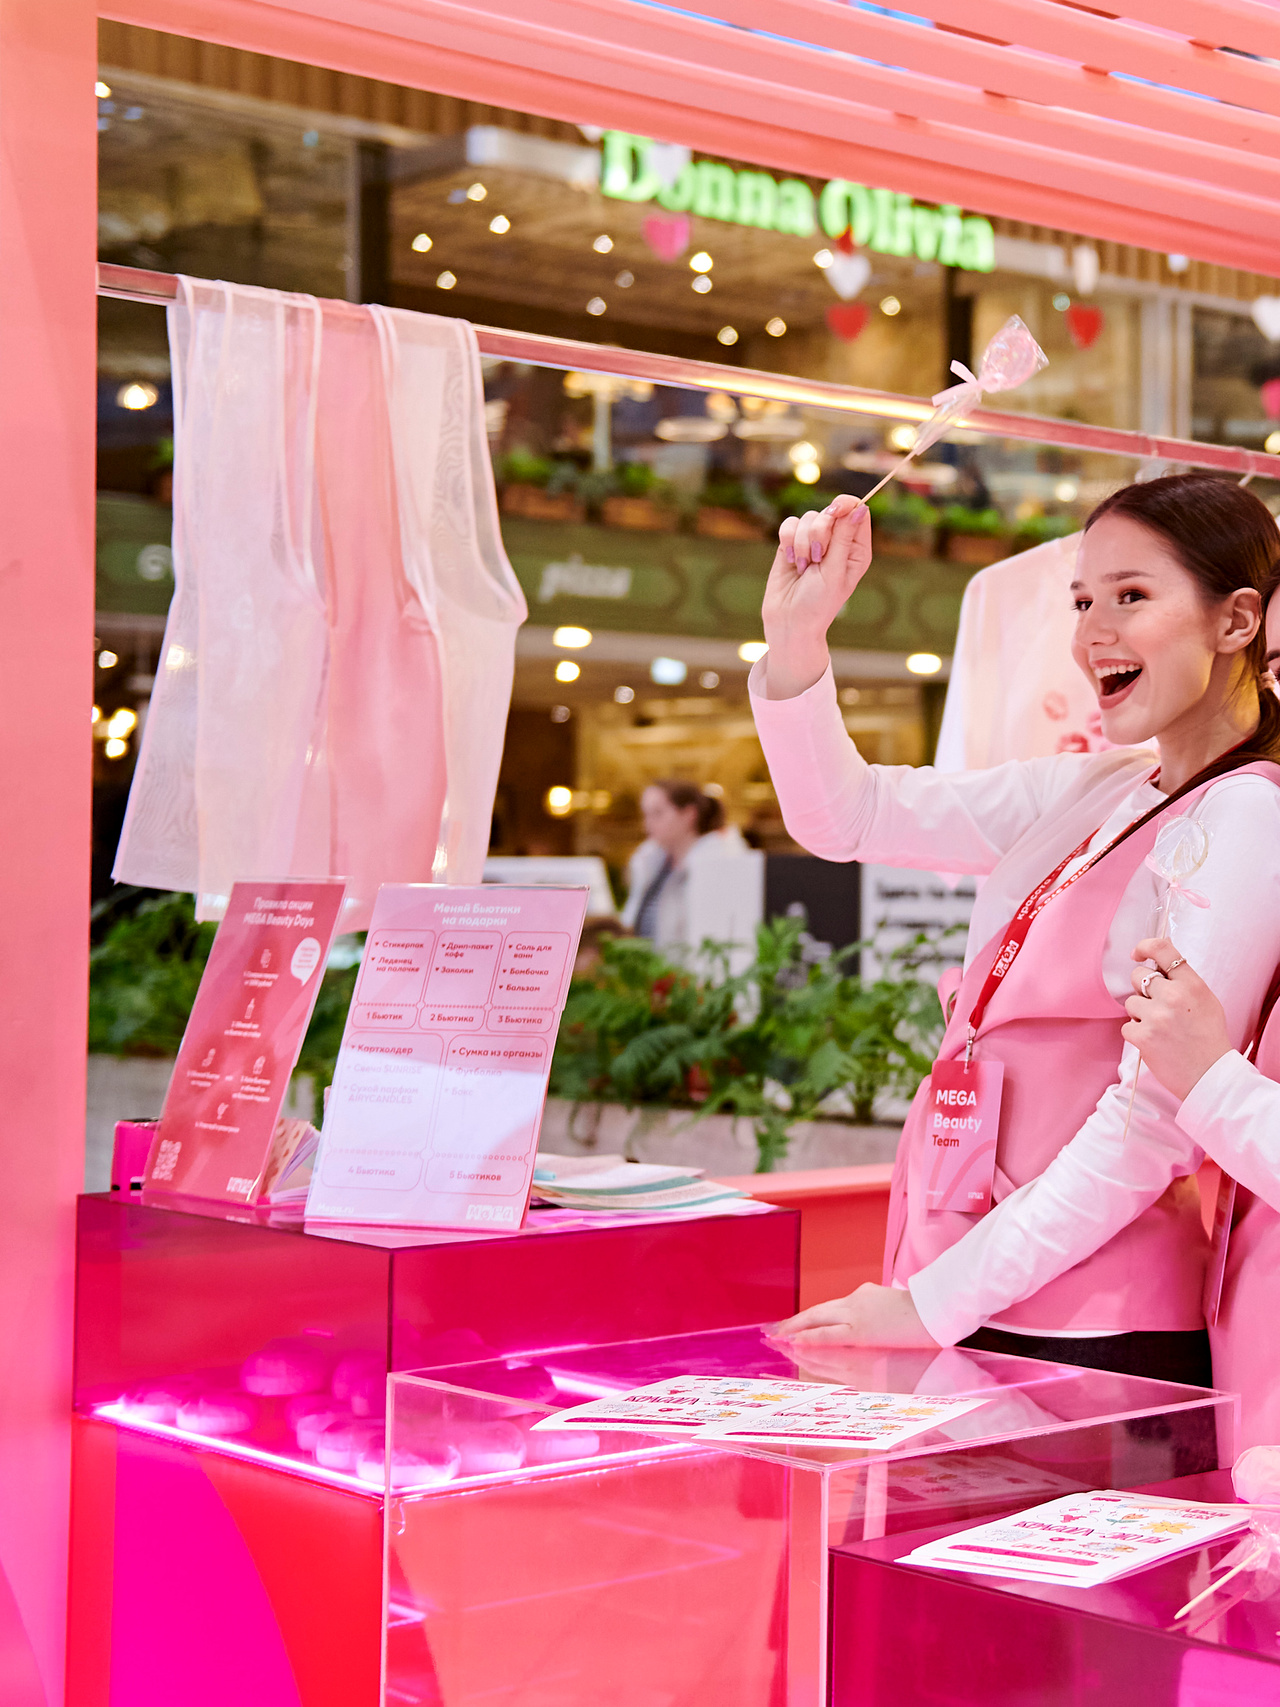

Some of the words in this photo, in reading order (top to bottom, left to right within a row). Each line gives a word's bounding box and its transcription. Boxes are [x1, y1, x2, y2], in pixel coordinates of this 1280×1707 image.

[818, 179, 996, 273] Olivia
[433, 903, 471, 915] Меняй
[472, 904, 521, 915] Бьютики
[442, 917, 458, 925] на
[458, 918, 508, 927] подарки
[515, 943, 535, 951] Соль
[536, 944, 552, 952] для
[444, 951, 464, 959] кофе
[378, 957, 413, 966] Леденец
[440, 967, 474, 975] Заколки
[509, 967, 549, 976] Бомбочка
[506, 984, 541, 992] Бальзам
[371, 1012, 403, 1021] Бьютик
[430, 1014, 436, 1022] 2
[437, 1014, 474, 1023] Бьютика
[504, 1016, 543, 1025] Бьютика
[357, 1043, 413, 1055] Картхолдер
[458, 1047, 489, 1057] Сумка
[490, 1049, 502, 1057] из
[503, 1049, 543, 1059] органзы
[455, 1067, 502, 1078] Футболка
[936, 1089, 977, 1106] MEGA
[933, 1113, 982, 1133] Beauty
[932, 1134, 960, 1147] Team
[355, 1167, 396, 1177] Бьютика
[449, 1171, 455, 1180] 5
[457, 1171, 502, 1181] Бьютиков
